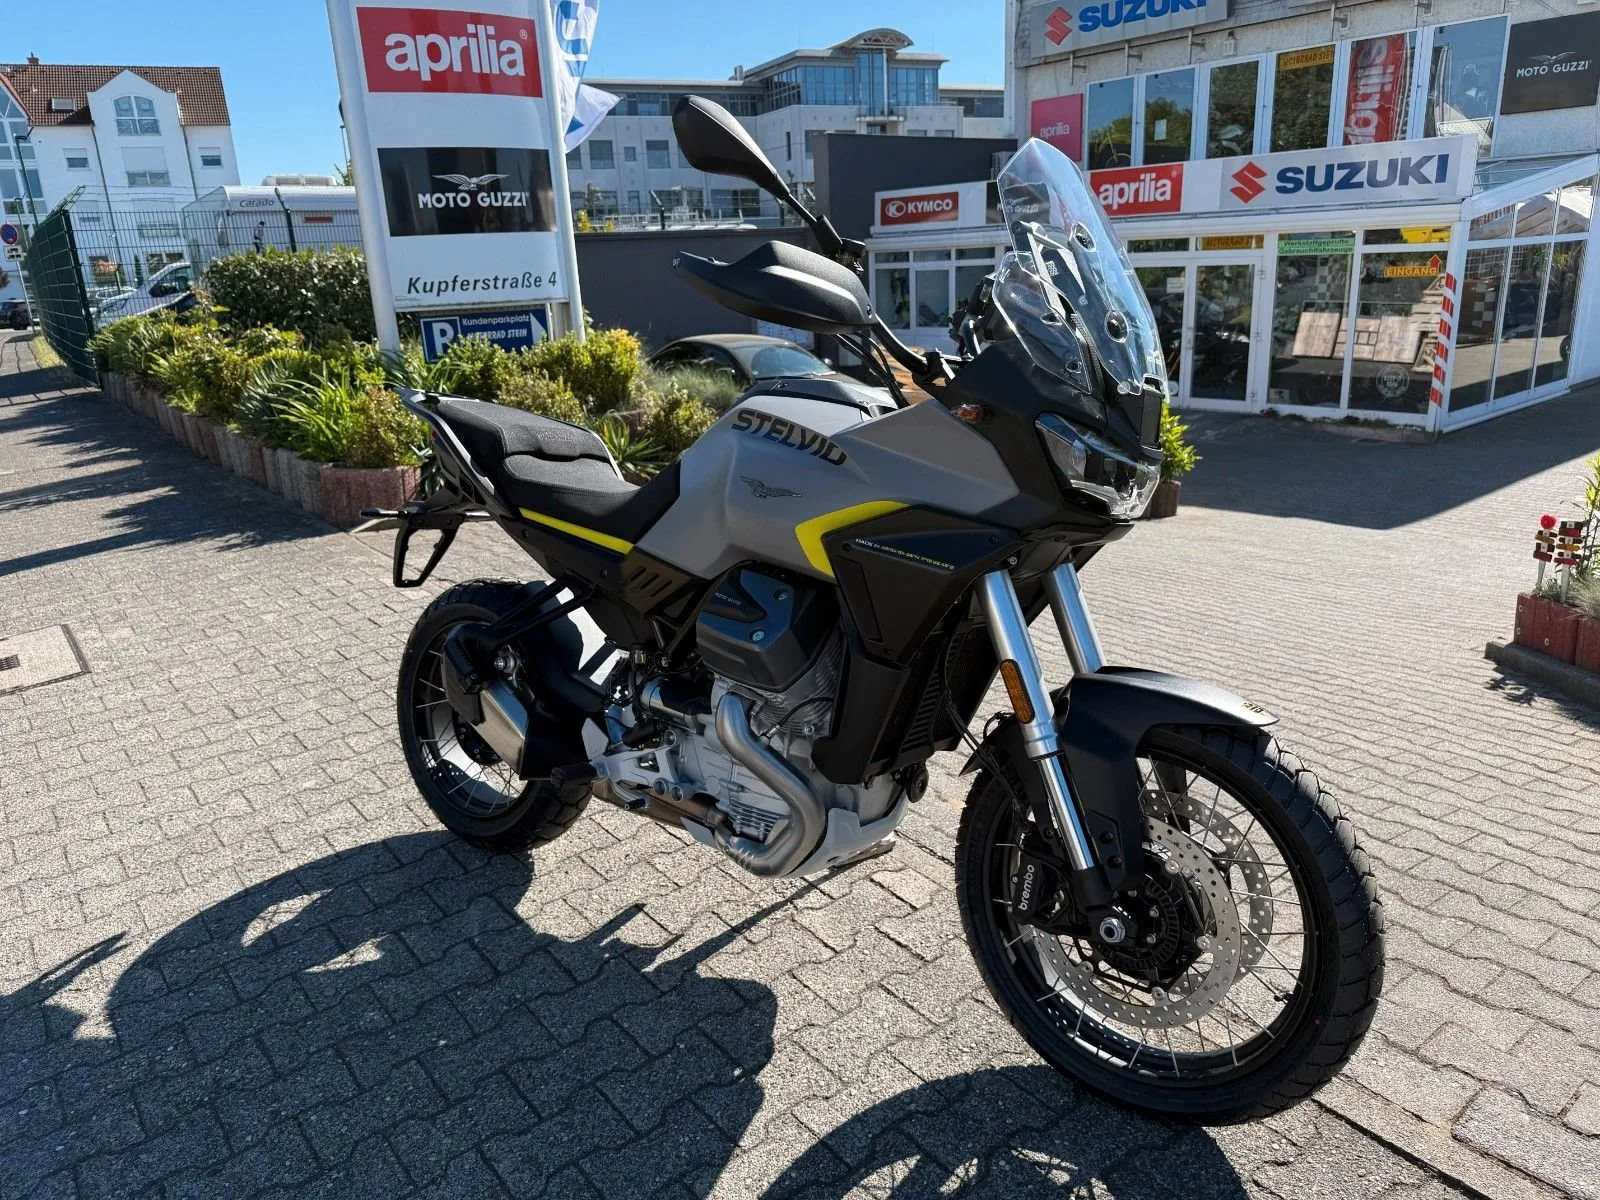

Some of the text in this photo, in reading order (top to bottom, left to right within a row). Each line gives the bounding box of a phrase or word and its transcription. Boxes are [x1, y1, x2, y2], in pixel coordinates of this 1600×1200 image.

[384, 24, 526, 82] aprilia
[1516, 60, 1589, 77] MOTO GUZZI
[1039, 122, 1071, 139] aprilia
[1275, 153, 1449, 194] SUZUKI
[417, 191, 527, 209] MOTO GUZZI
[1097, 172, 1172, 210] aprilia
[907, 199, 953, 214] KYMCO
[1386, 267, 1438, 277] EINGANG
[407, 271, 558, 297] Kupferstraße 4
[462, 314, 530, 326] Kundenparkplatz
[432, 321, 455, 354] P
[507, 328, 528, 338] STEIN
[731, 409, 847, 466] STELVIO
[1018, 864, 1035, 911] brembo
